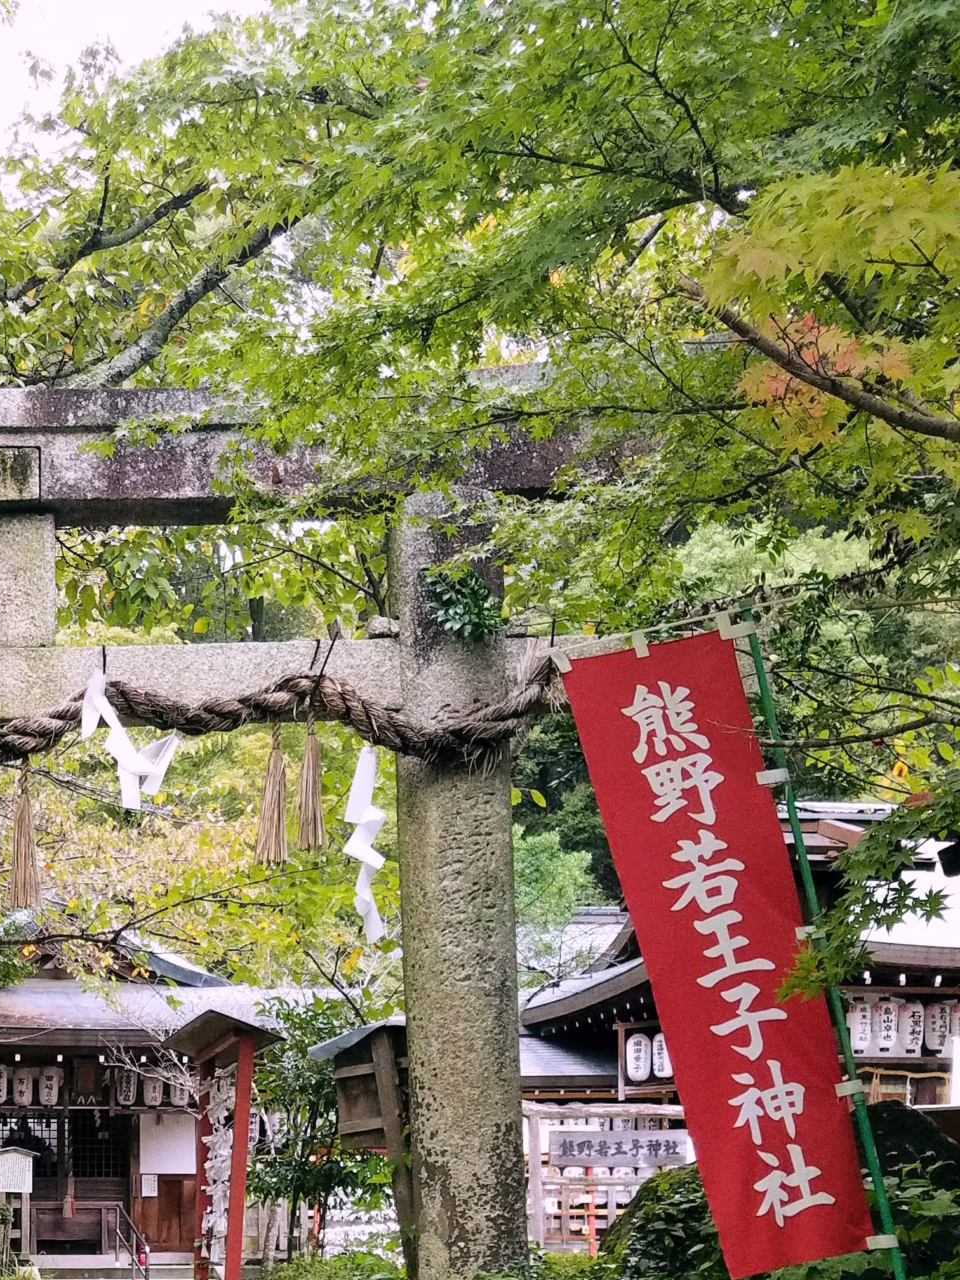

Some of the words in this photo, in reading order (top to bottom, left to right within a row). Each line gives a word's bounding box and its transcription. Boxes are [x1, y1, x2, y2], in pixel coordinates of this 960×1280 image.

[622, 681, 836, 1229] 熊野若王子神社
[558, 1138, 681, 1158] 熊野若王子神社
